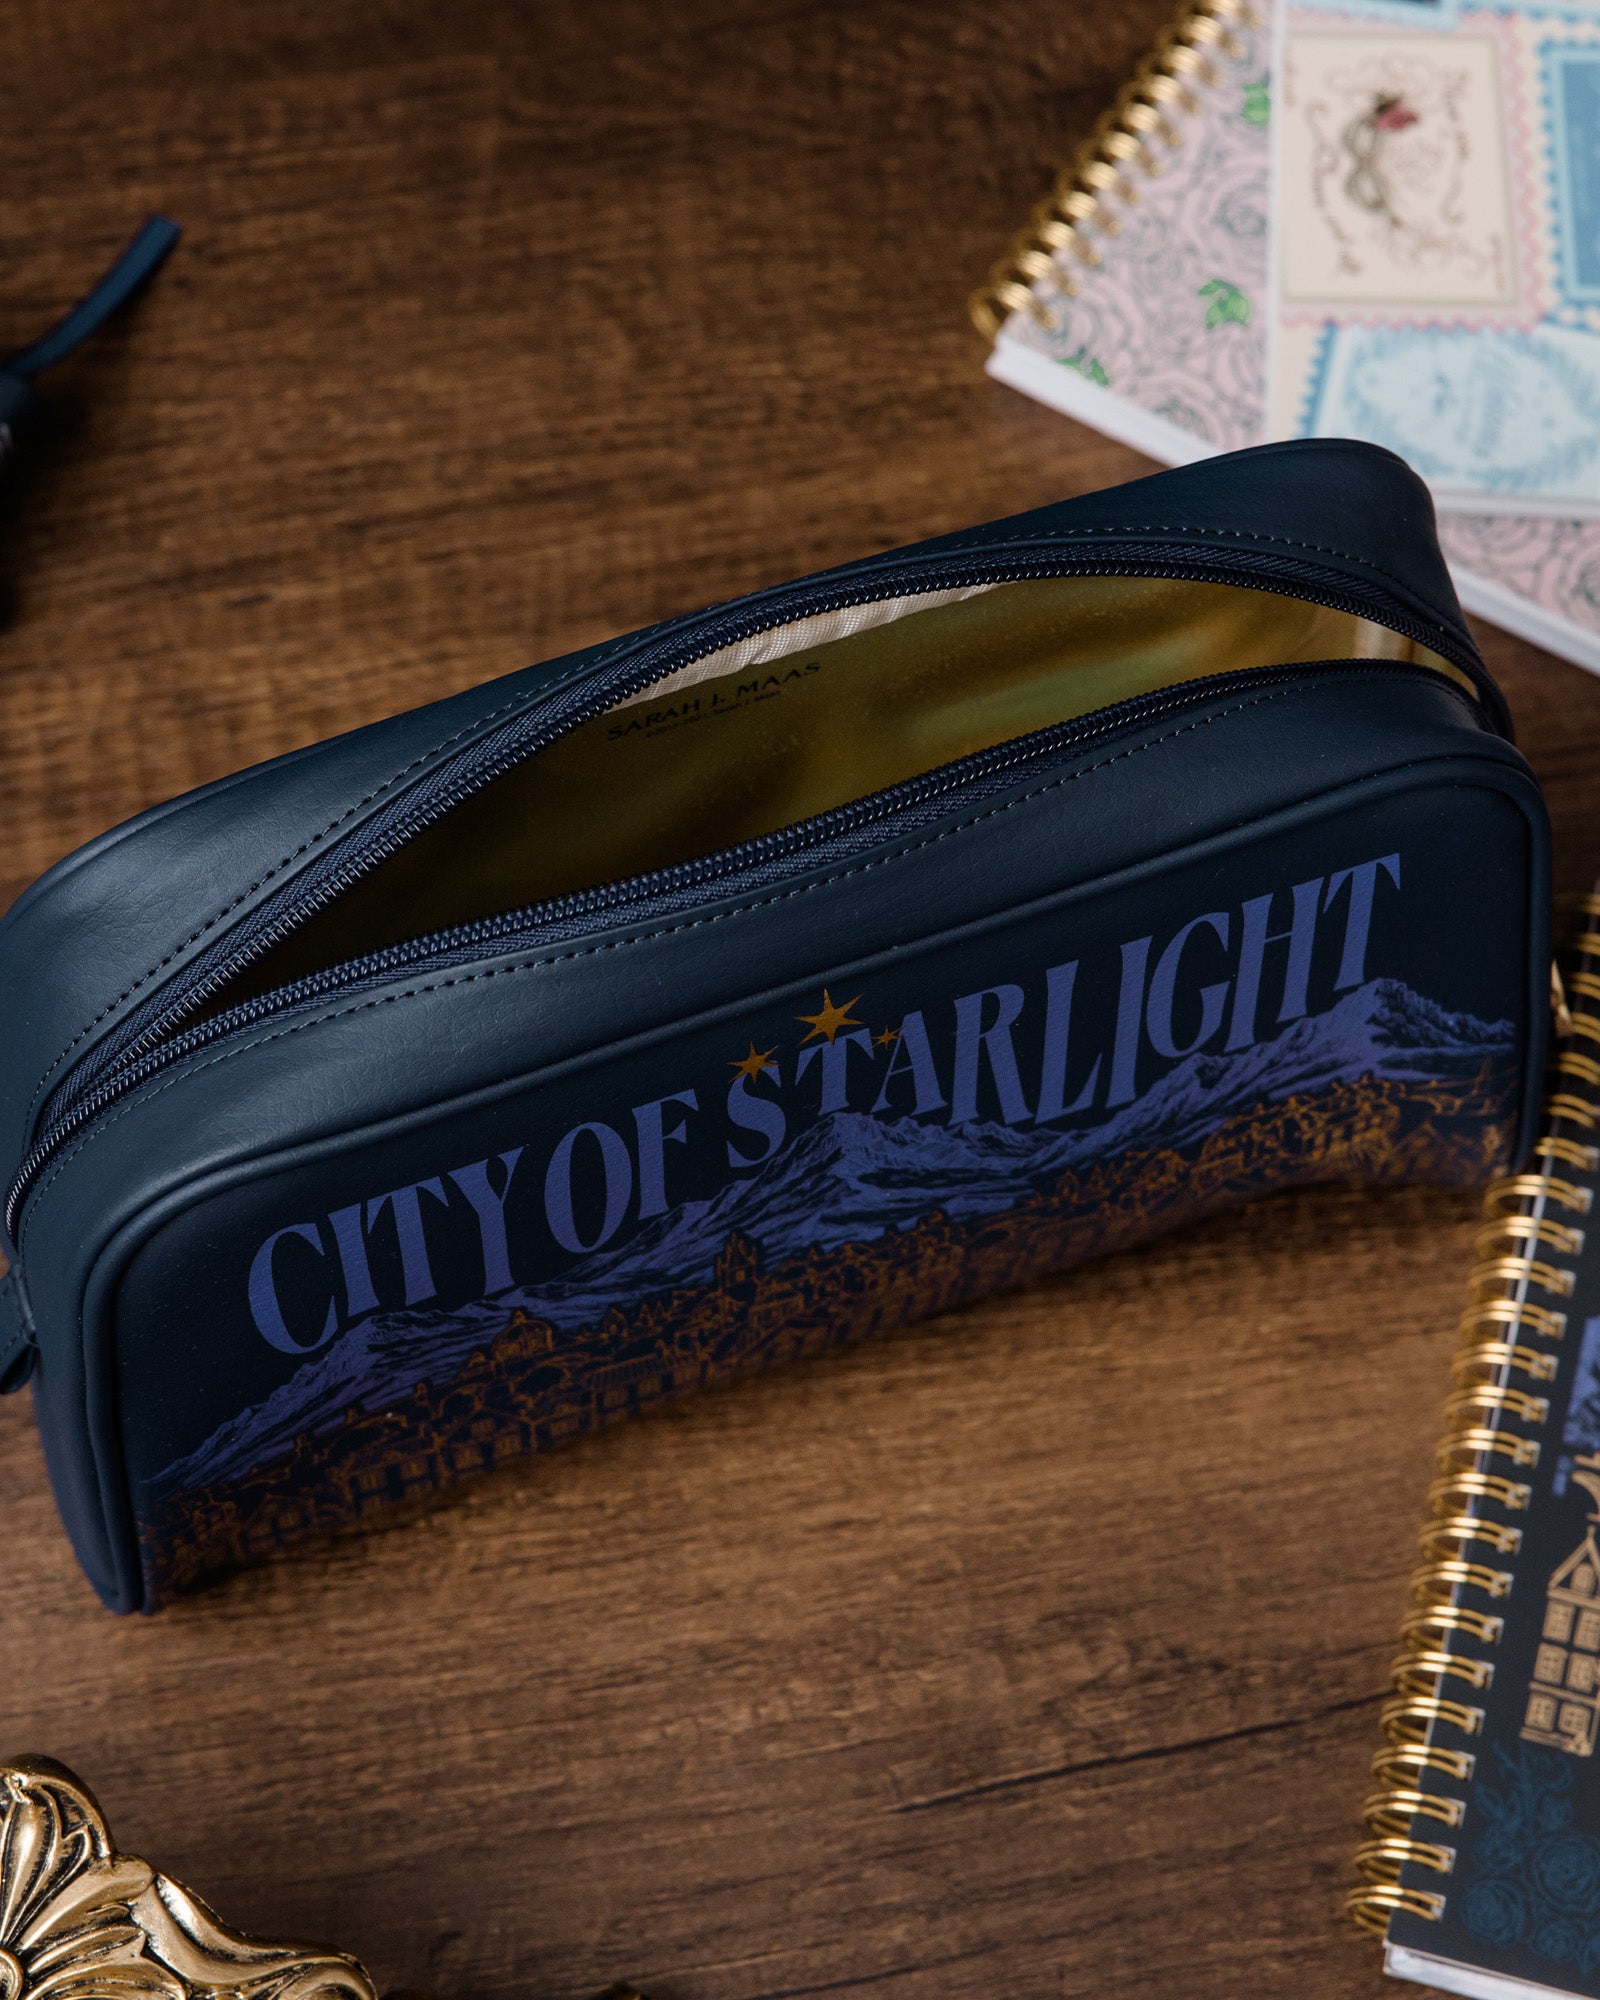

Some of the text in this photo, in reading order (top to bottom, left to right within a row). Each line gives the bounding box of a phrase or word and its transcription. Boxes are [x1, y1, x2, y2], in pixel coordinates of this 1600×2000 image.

[608, 699, 700, 741] SARAH
[737, 662, 821, 697] MAAS
[248, 853, 1401, 1355] CITY OF STARLIGHT
